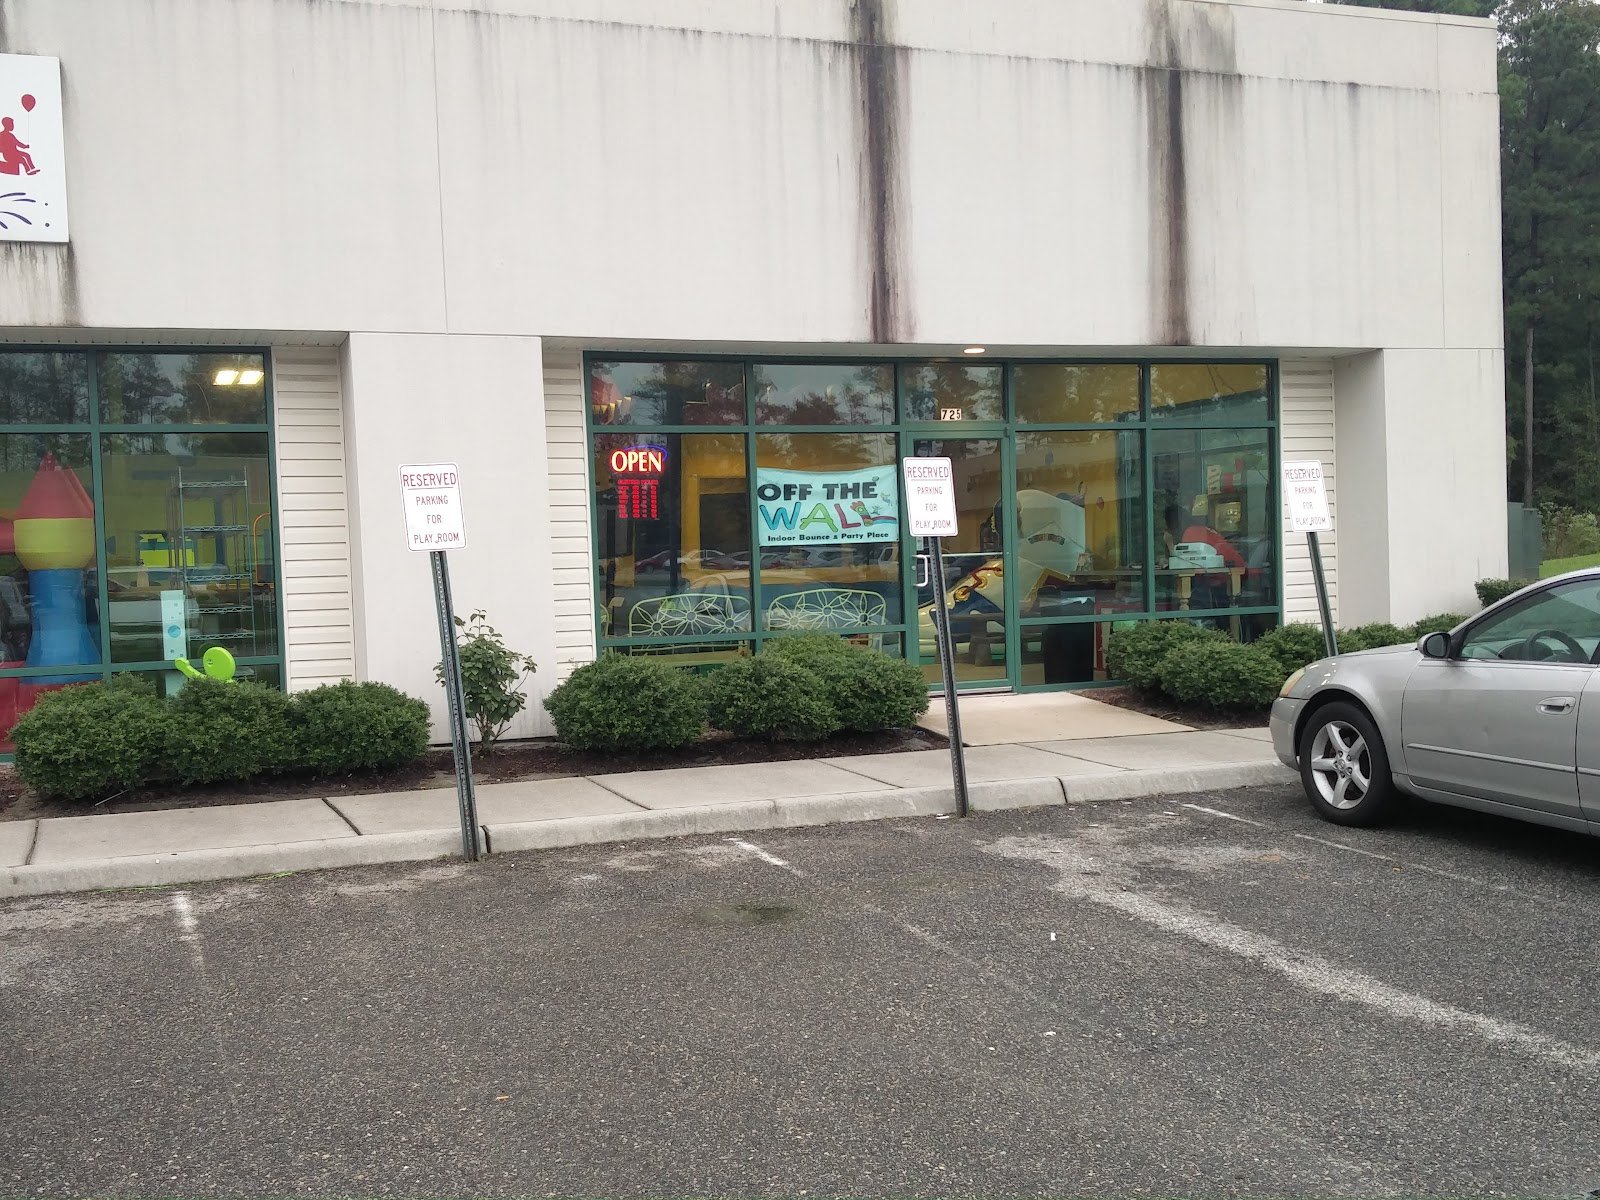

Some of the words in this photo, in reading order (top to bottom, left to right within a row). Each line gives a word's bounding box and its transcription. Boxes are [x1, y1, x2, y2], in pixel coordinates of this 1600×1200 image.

[941, 409, 961, 420] 725
[611, 450, 662, 472] OPEN
[907, 466, 949, 478] RESERVED
[1285, 468, 1320, 479] RESERVED
[402, 473, 456, 487] RESERVED
[757, 483, 813, 501] OFF
[822, 481, 879, 500] THE
[917, 487, 943, 495] PARKING
[415, 495, 449, 506] PARKING
[925, 503, 938, 512] FOR
[426, 514, 442, 524] FOR
[759, 501, 897, 533] WALL
[915, 520, 931, 529] PLAY
[934, 519, 951, 529] ROOM
[413, 534, 433, 544] PLAY
[437, 532, 460, 543] ROOM
[799, 533, 830, 541] Bounce
[841, 532, 864, 540] Party
